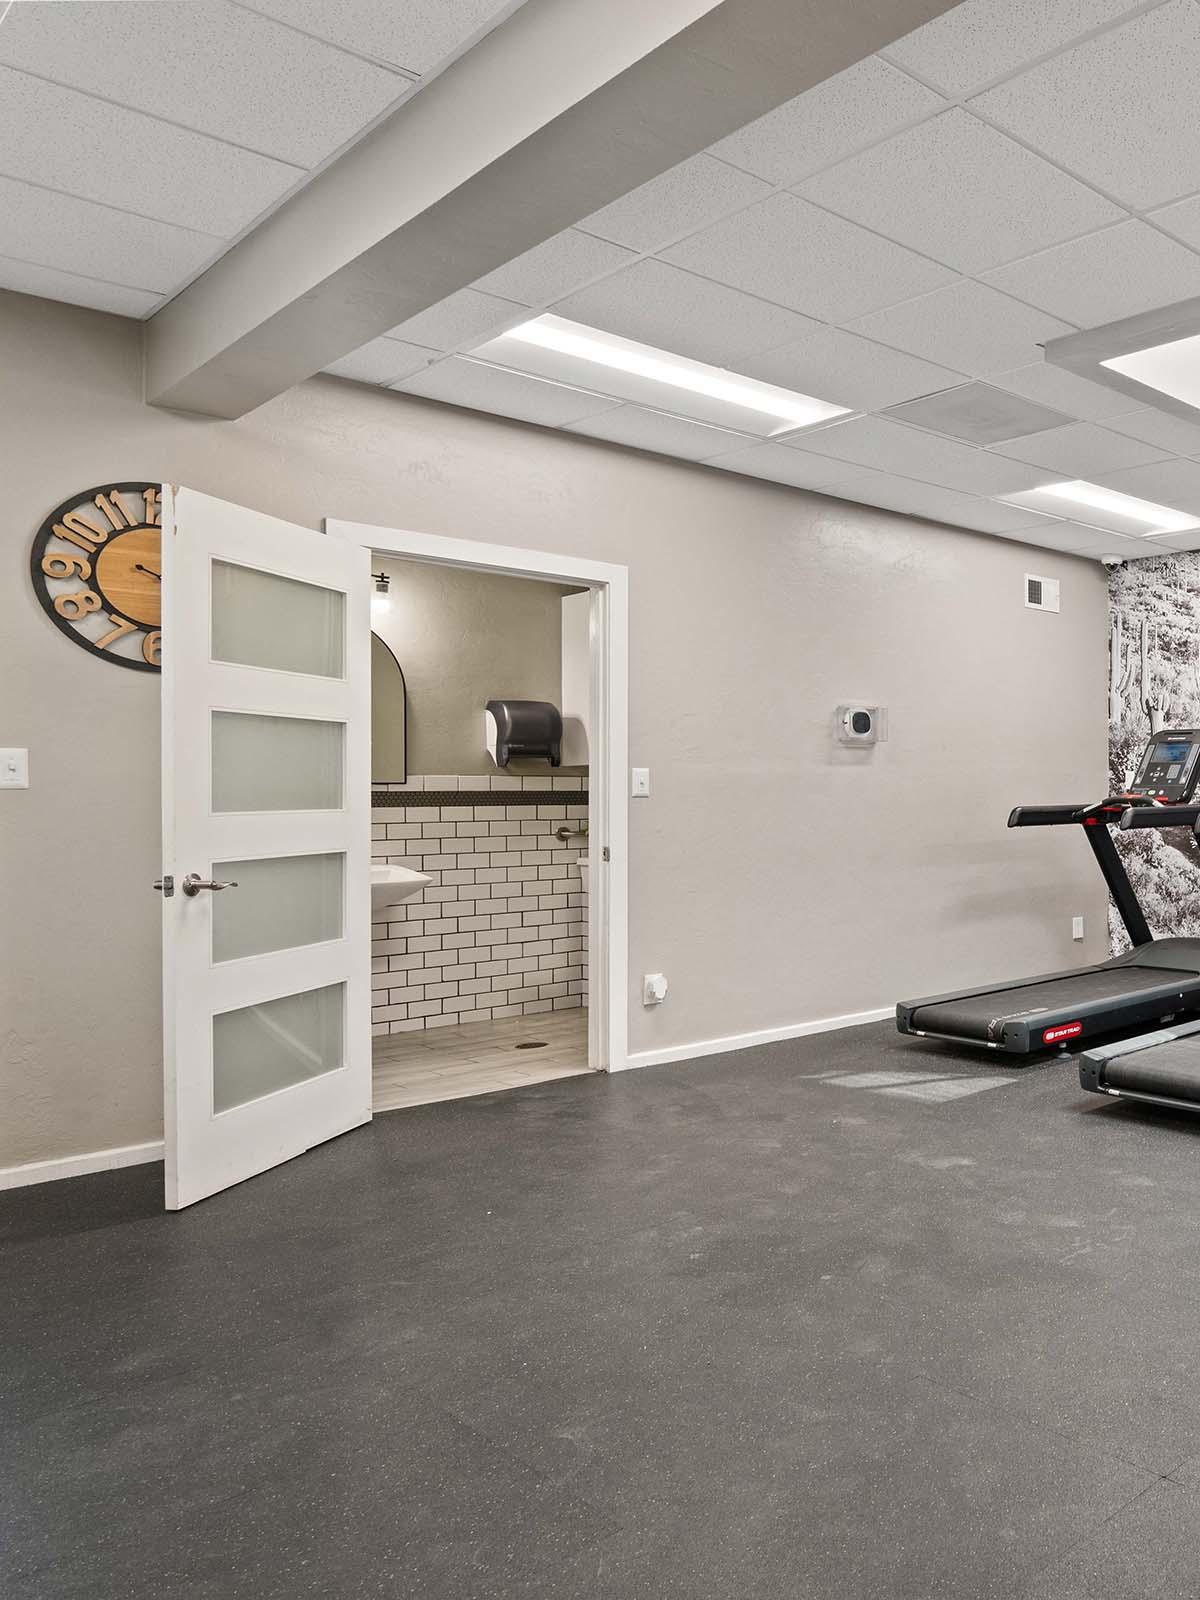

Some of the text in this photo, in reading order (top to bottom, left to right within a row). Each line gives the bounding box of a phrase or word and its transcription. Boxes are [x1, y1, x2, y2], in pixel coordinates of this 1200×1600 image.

[95, 490, 138, 530] 11
[52, 512, 108, 553] 10
[41, 553, 92, 581] 9
[54, 590, 102, 621] 8
[95, 614, 139, 649] 7
